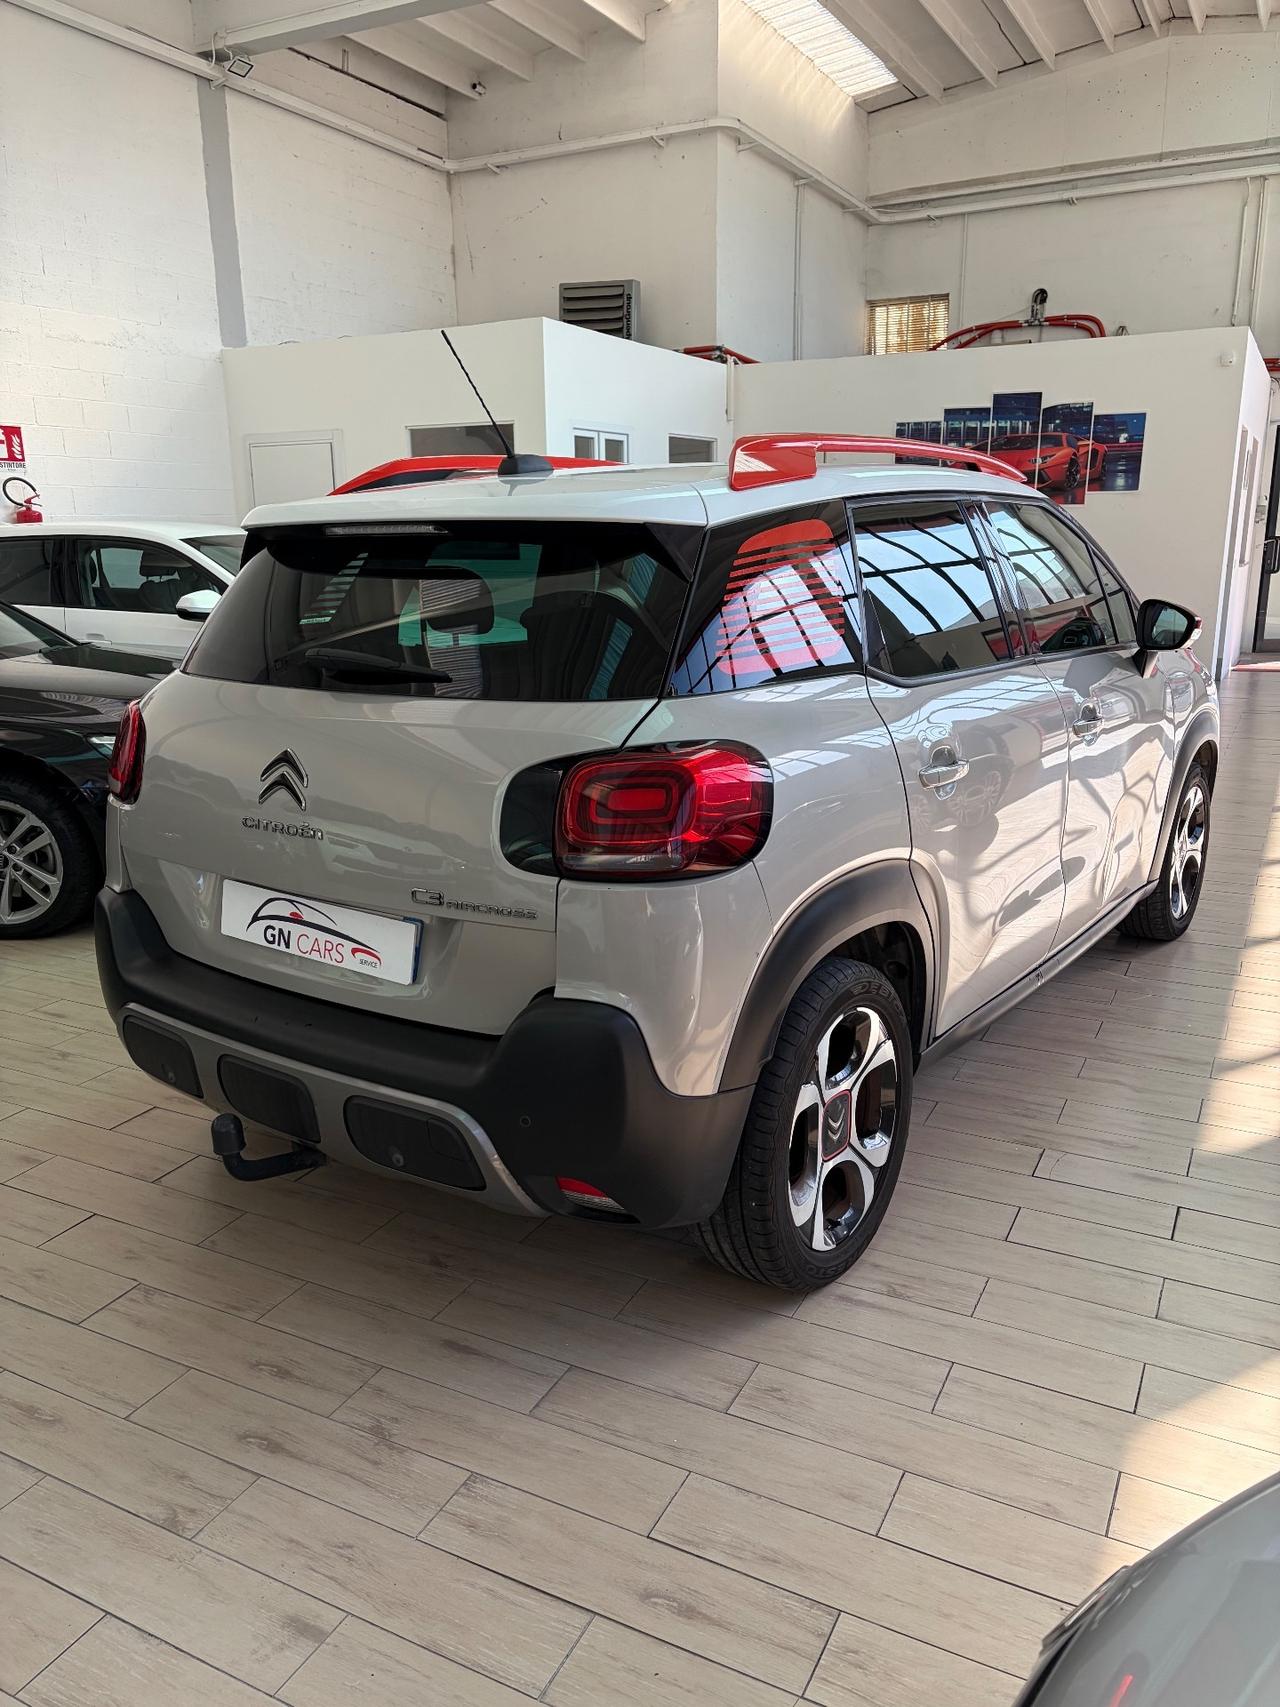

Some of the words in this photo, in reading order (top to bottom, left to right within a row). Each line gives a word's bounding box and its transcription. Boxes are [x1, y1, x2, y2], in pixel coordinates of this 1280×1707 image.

[411, 888, 445, 906] C3
[263, 924, 292, 949] GN
[297, 933, 345, 964] CARS
[359, 958, 378, 968] SERVICE
